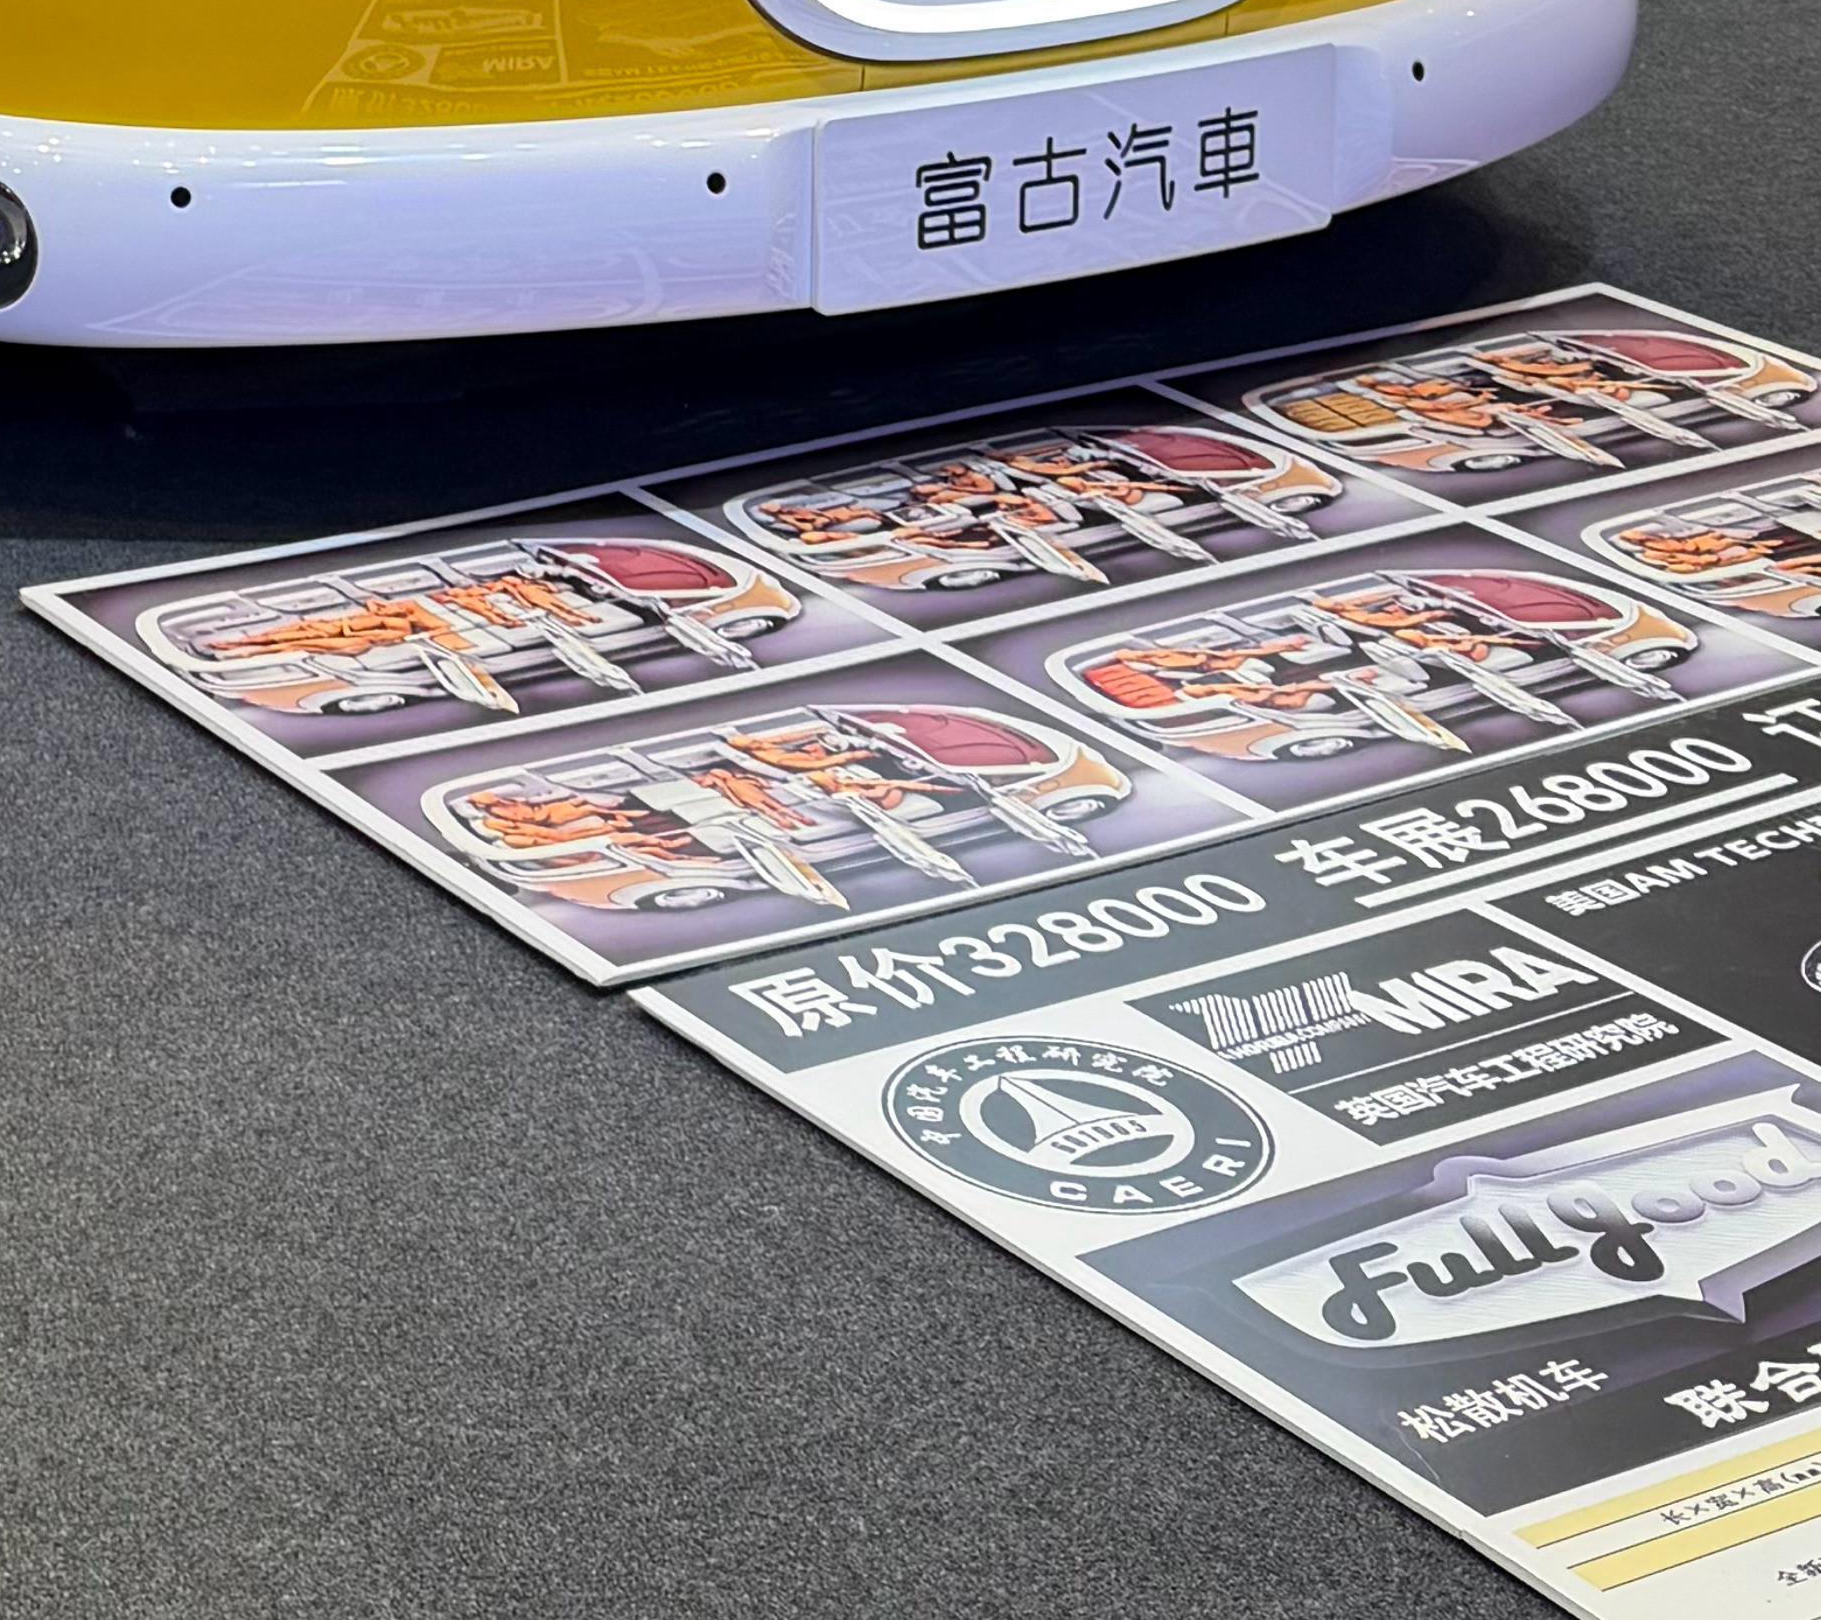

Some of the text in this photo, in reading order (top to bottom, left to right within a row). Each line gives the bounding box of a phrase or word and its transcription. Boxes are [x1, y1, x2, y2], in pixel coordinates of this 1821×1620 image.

[915, 106, 1260, 251] 富古汽車
[1693, 815, 1821, 867] TECH
[728, 873, 1267, 1038] 原价328000
[1274, 736, 1753, 886] 车展268000
[1349, 946, 1599, 1035] MIRA
[1334, 1013, 1680, 1127] 英国汽车工程研究院
[1049, 1136, 1252, 1203] CAERI
[1396, 1358, 1610, 1444] 松散机车
[1662, 1342, 1821, 1429] 联合
